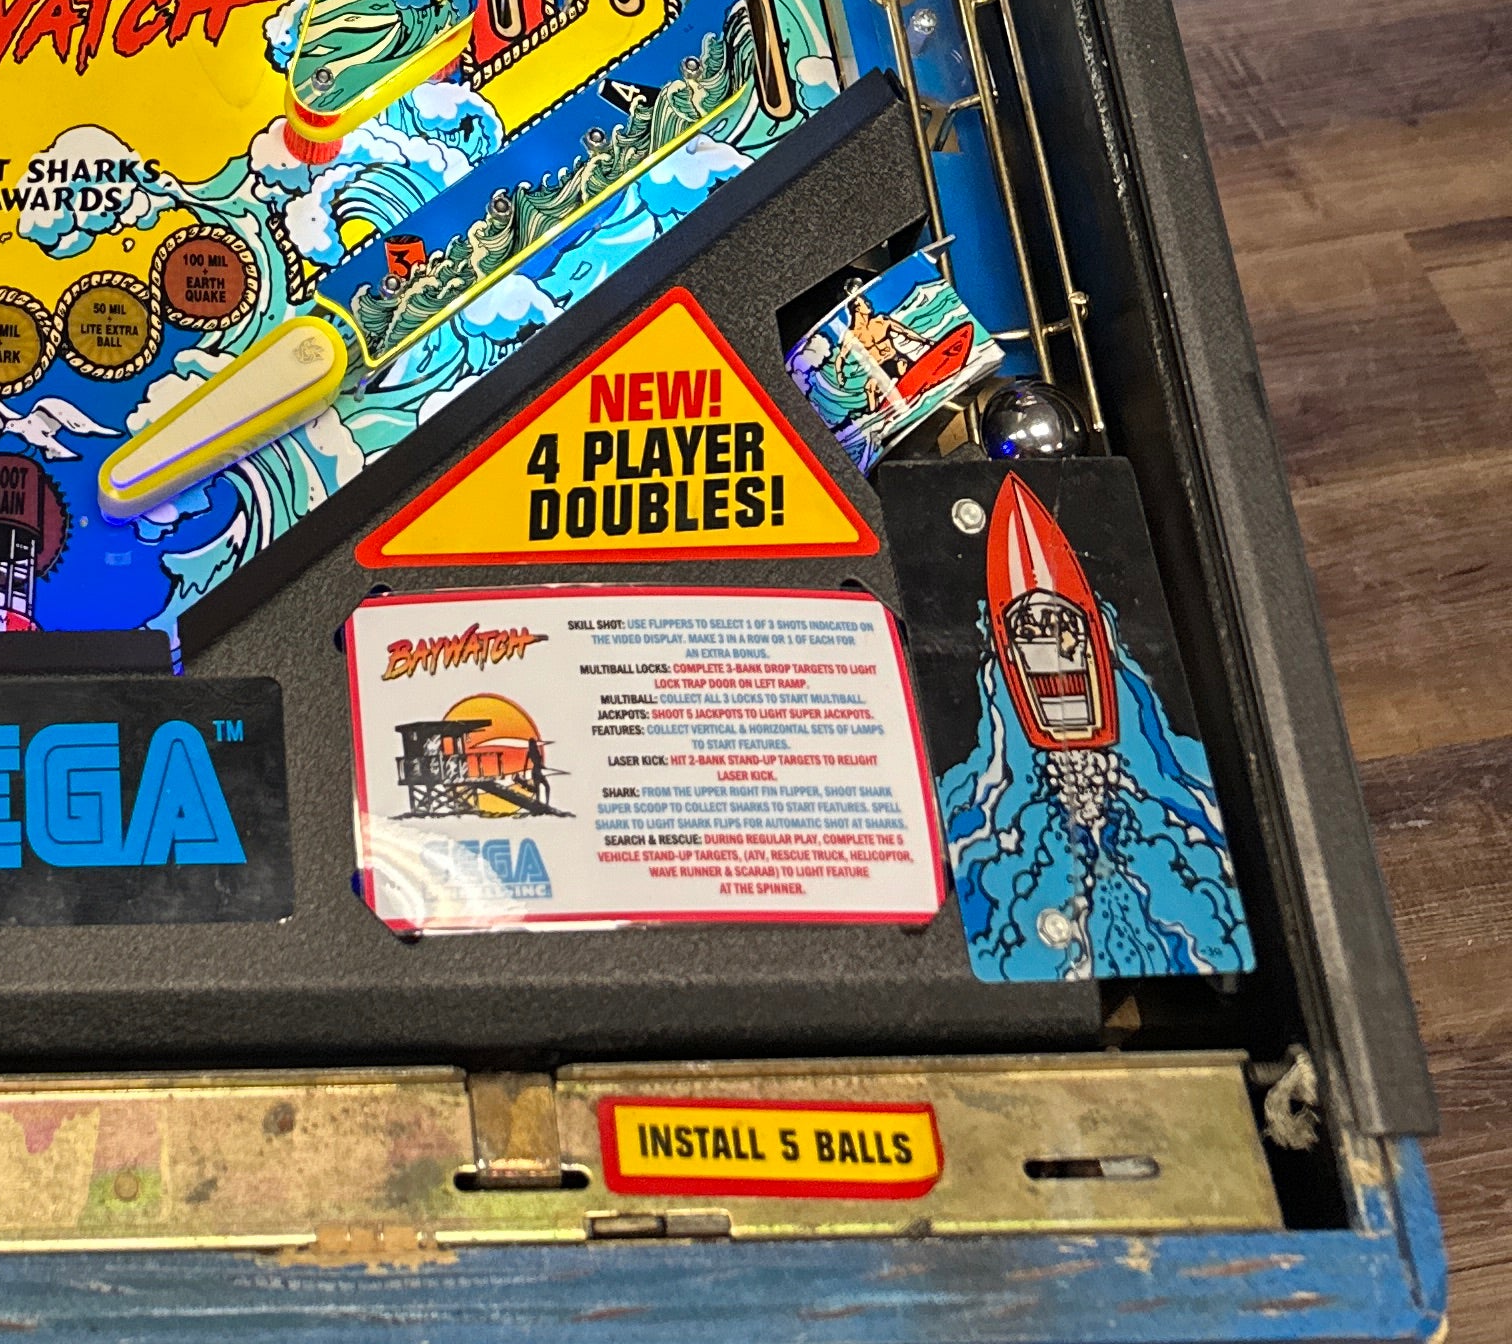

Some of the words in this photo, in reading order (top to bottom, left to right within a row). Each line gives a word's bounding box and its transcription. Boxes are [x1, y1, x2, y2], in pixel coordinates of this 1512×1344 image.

[28, 158, 162, 185] SHARKS
[186, 277, 225, 289] EARTH
[184, 289, 226, 304] QUAKE
[80, 324, 103, 335] LITE
[105, 324, 139, 336] EXTRA
[96, 336, 122, 348] BALL
[589, 369, 722, 423] NEW!
[527, 432, 559, 485] 4
[590, 422, 766, 482] PLAYER
[528, 474, 786, 542] DOUBLES!
[567, 620, 595, 631] SKILL
[597, 620, 626, 630] SHOT:
[382, 623, 549, 681] BAYWATCH
[580, 664, 634, 675] MULTIBALL
[636, 664, 671, 675] LOCKS:
[793, 664, 834, 675] TARGETS
[600, 694, 658, 705] MULTIBALL:
[659, 694, 701, 704] COLLECT
[598, 710, 650, 720] JACKPOTS:
[694, 709, 743, 720] JACKPOTS
[592, 725, 645, 736] FEATURES:
[749, 724, 809, 735] HORIZONTAL
[608, 756, 640, 766] LASER
[642, 756, 669, 766] KICK:
[728, 755, 776, 766] STAND-UP
[602, 788, 640, 798] SHARK:
[604, 835, 646, 846] SEARCH
[659, 835, 702, 846] RESCUE:
[849, 850, 913, 863] HELICOPTOR,
[757, 884, 806, 895] SPINNER.
[637, 1122, 766, 1162] INSTALL
[779, 1128, 799, 1162] 5
[814, 1128, 913, 1166] BALLS
